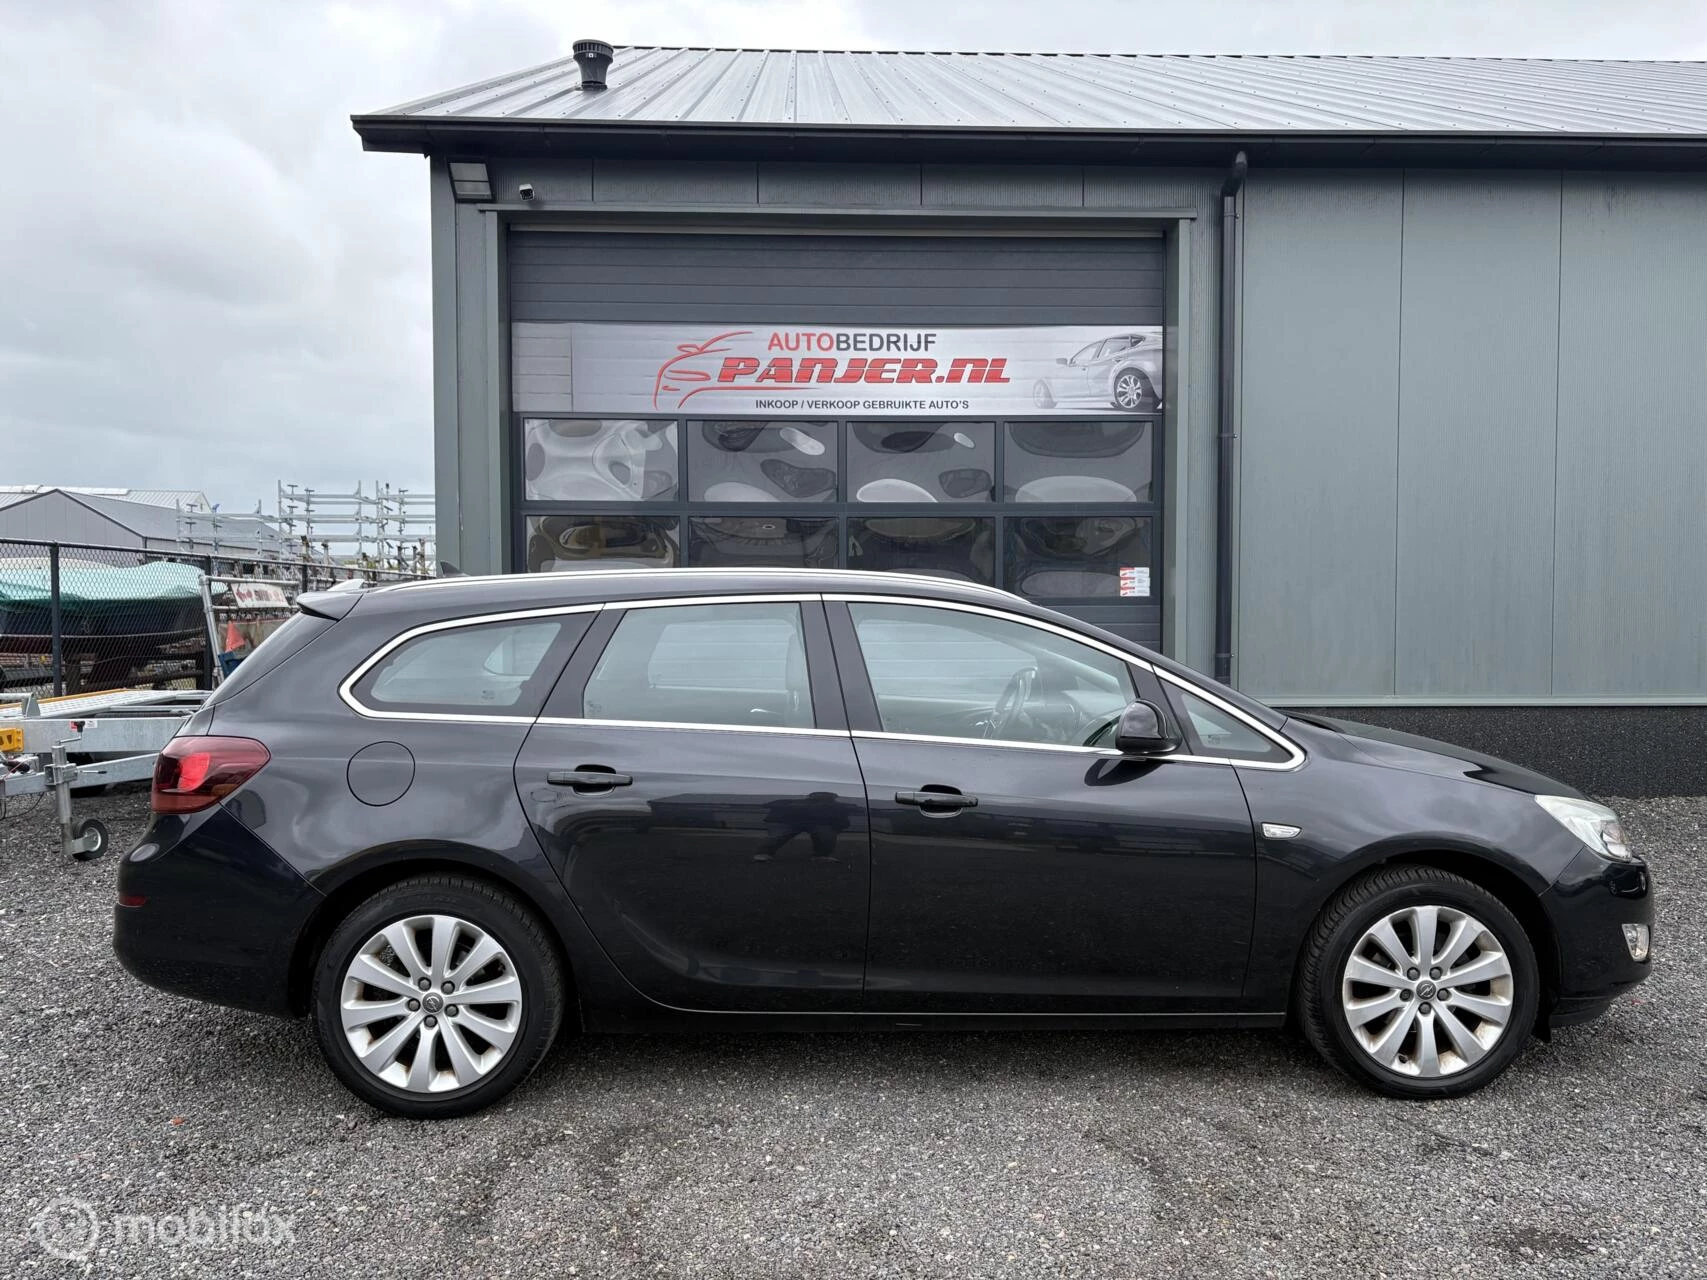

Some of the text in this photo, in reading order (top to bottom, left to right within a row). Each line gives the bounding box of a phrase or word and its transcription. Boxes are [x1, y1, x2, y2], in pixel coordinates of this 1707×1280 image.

[768, 332, 937, 352] AUTOBEDRIJF
[755, 400, 798, 409] INKOOP
[807, 400, 860, 409] VERKOOP
[863, 400, 926, 409] GEBRUIKTE
[929, 400, 969, 409] AUTO'S
